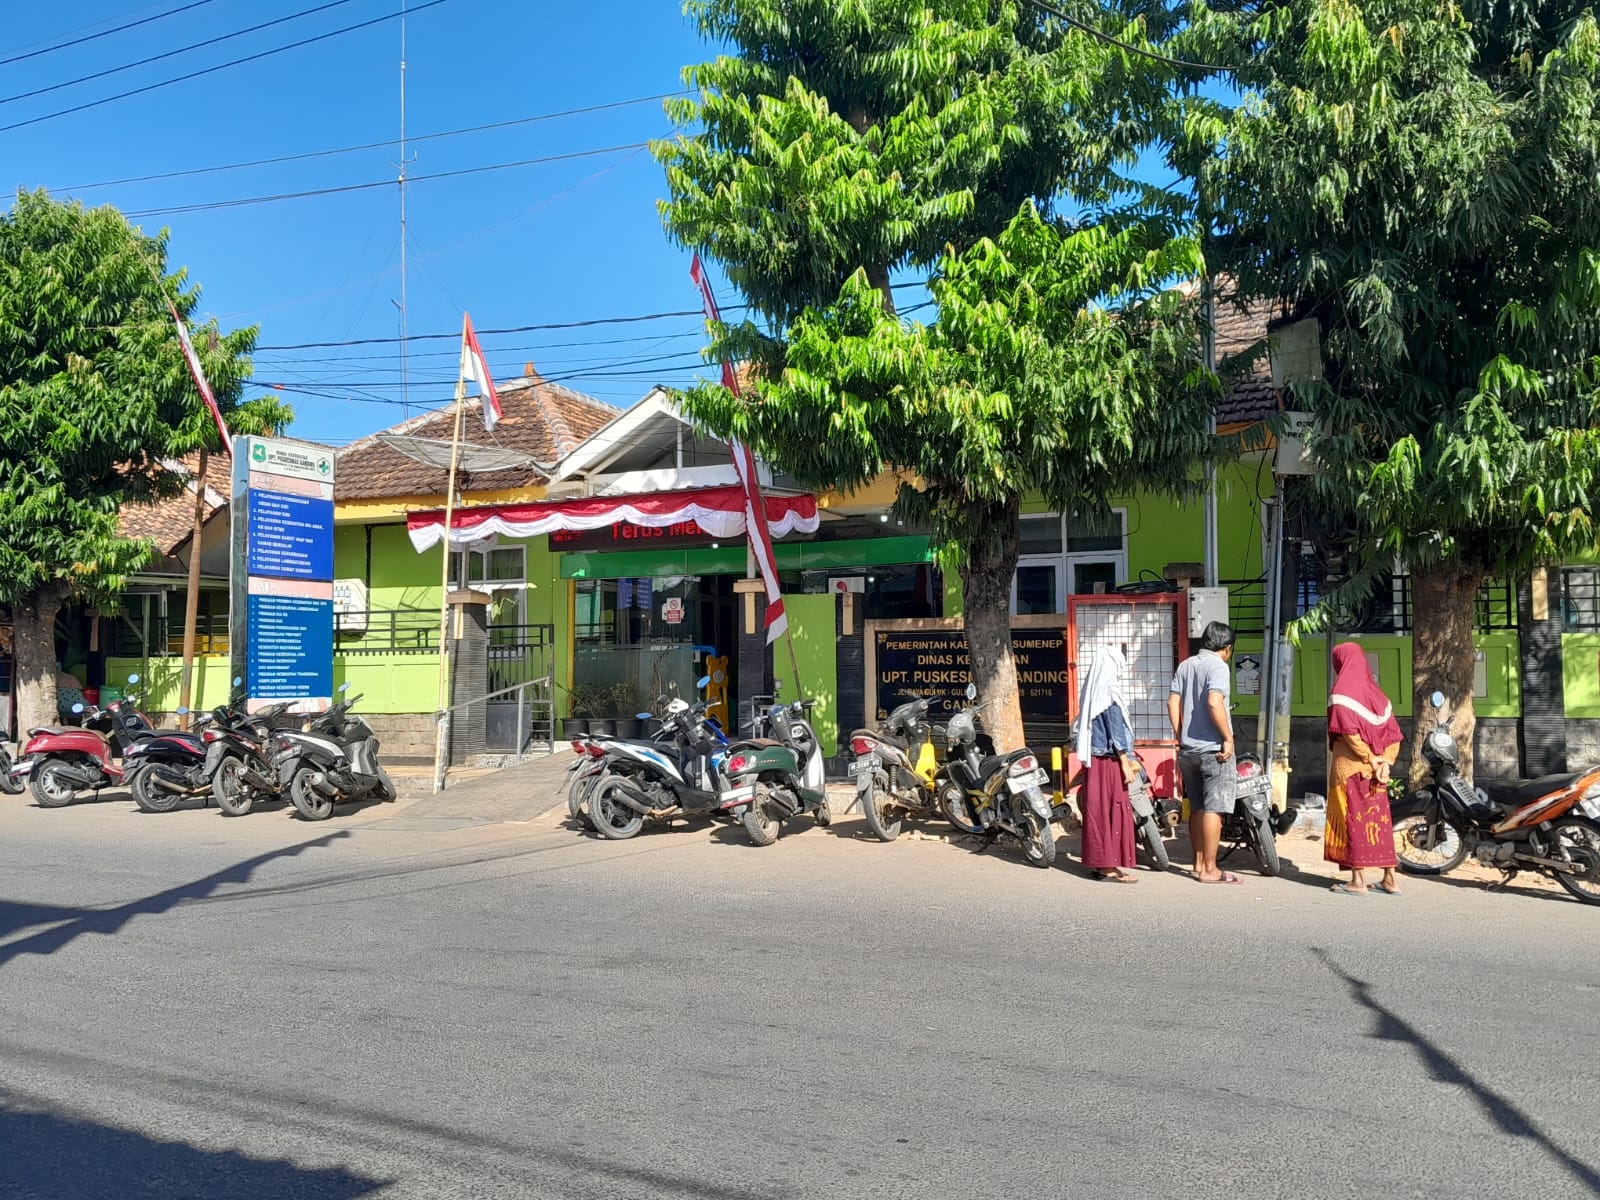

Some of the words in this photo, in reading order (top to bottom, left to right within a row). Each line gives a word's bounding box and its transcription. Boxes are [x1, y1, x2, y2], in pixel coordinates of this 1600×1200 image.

[611, 520, 662, 539] Terus
[886, 640, 947, 650] PEMERINTAH
[1012, 640, 1063, 648] SUMENEP
[918, 654, 952, 665] DINAS
[956, 655, 970, 664] KE
[882, 671, 910, 683] UPT.
[1016, 671, 1068, 683] ANDING
